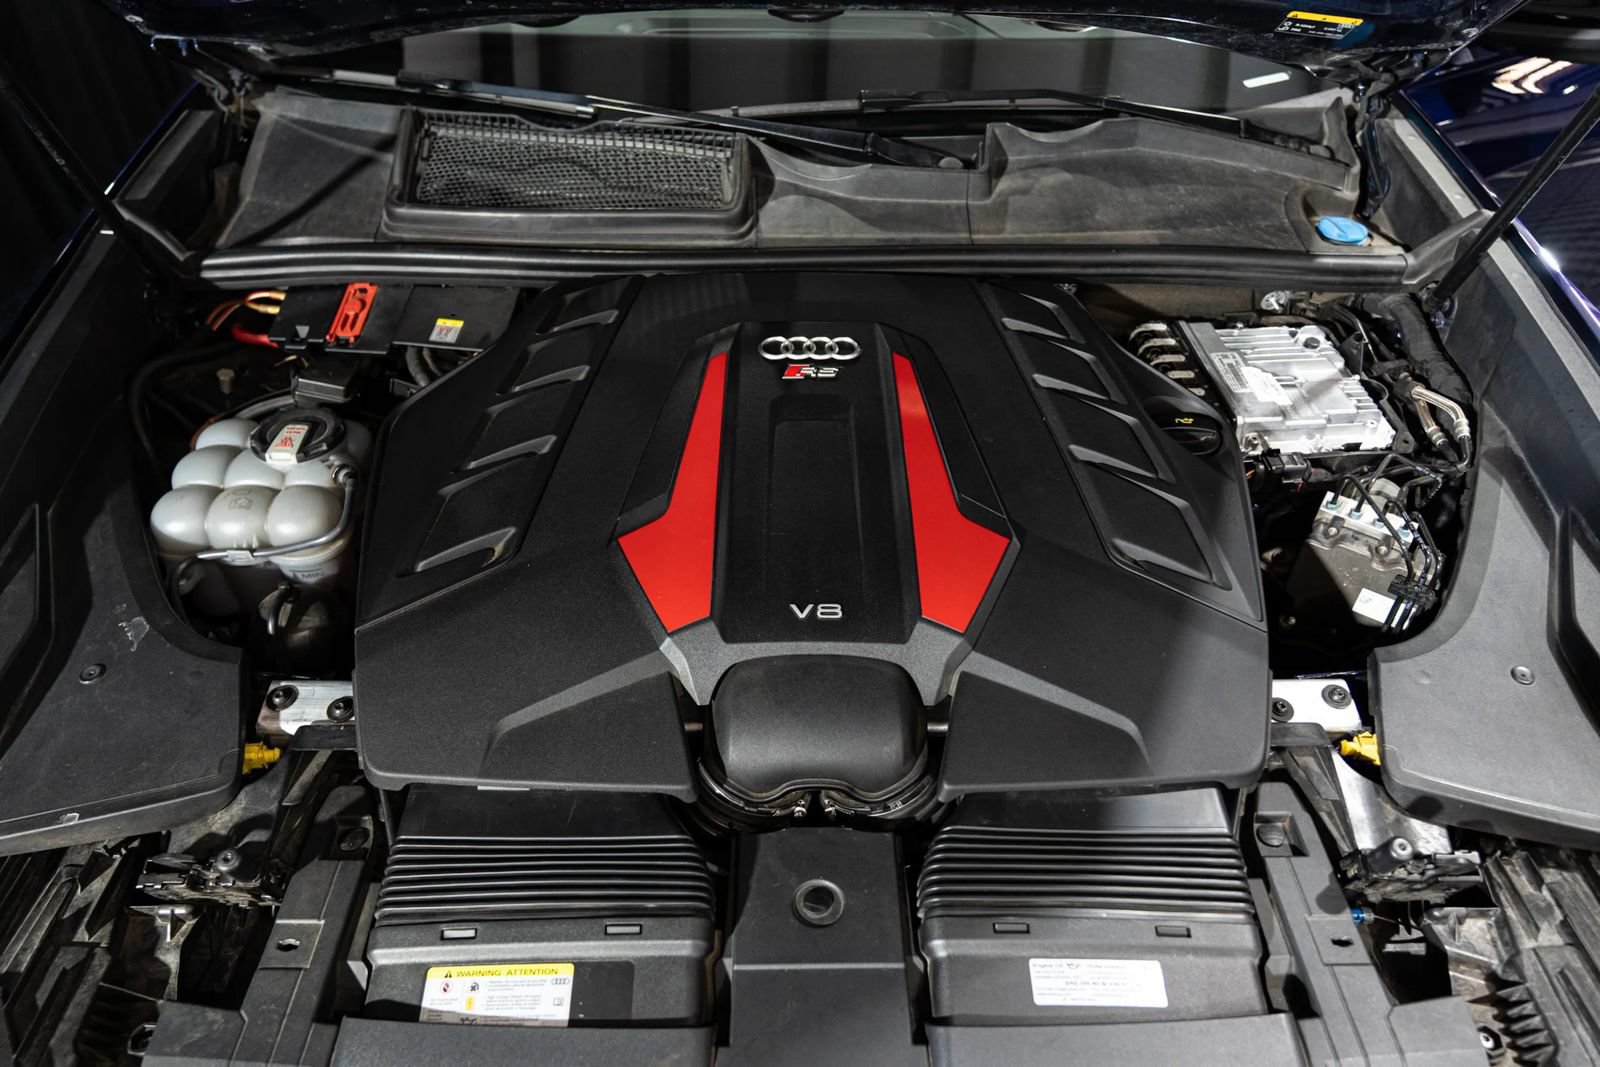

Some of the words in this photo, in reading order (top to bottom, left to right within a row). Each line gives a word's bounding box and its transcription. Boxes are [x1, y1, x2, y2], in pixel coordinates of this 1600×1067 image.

[787, 365, 839, 379] RS
[790, 603, 842, 619] V8
[456, 968, 501, 977] WARNING
[507, 968, 558, 976] ATTENTION
